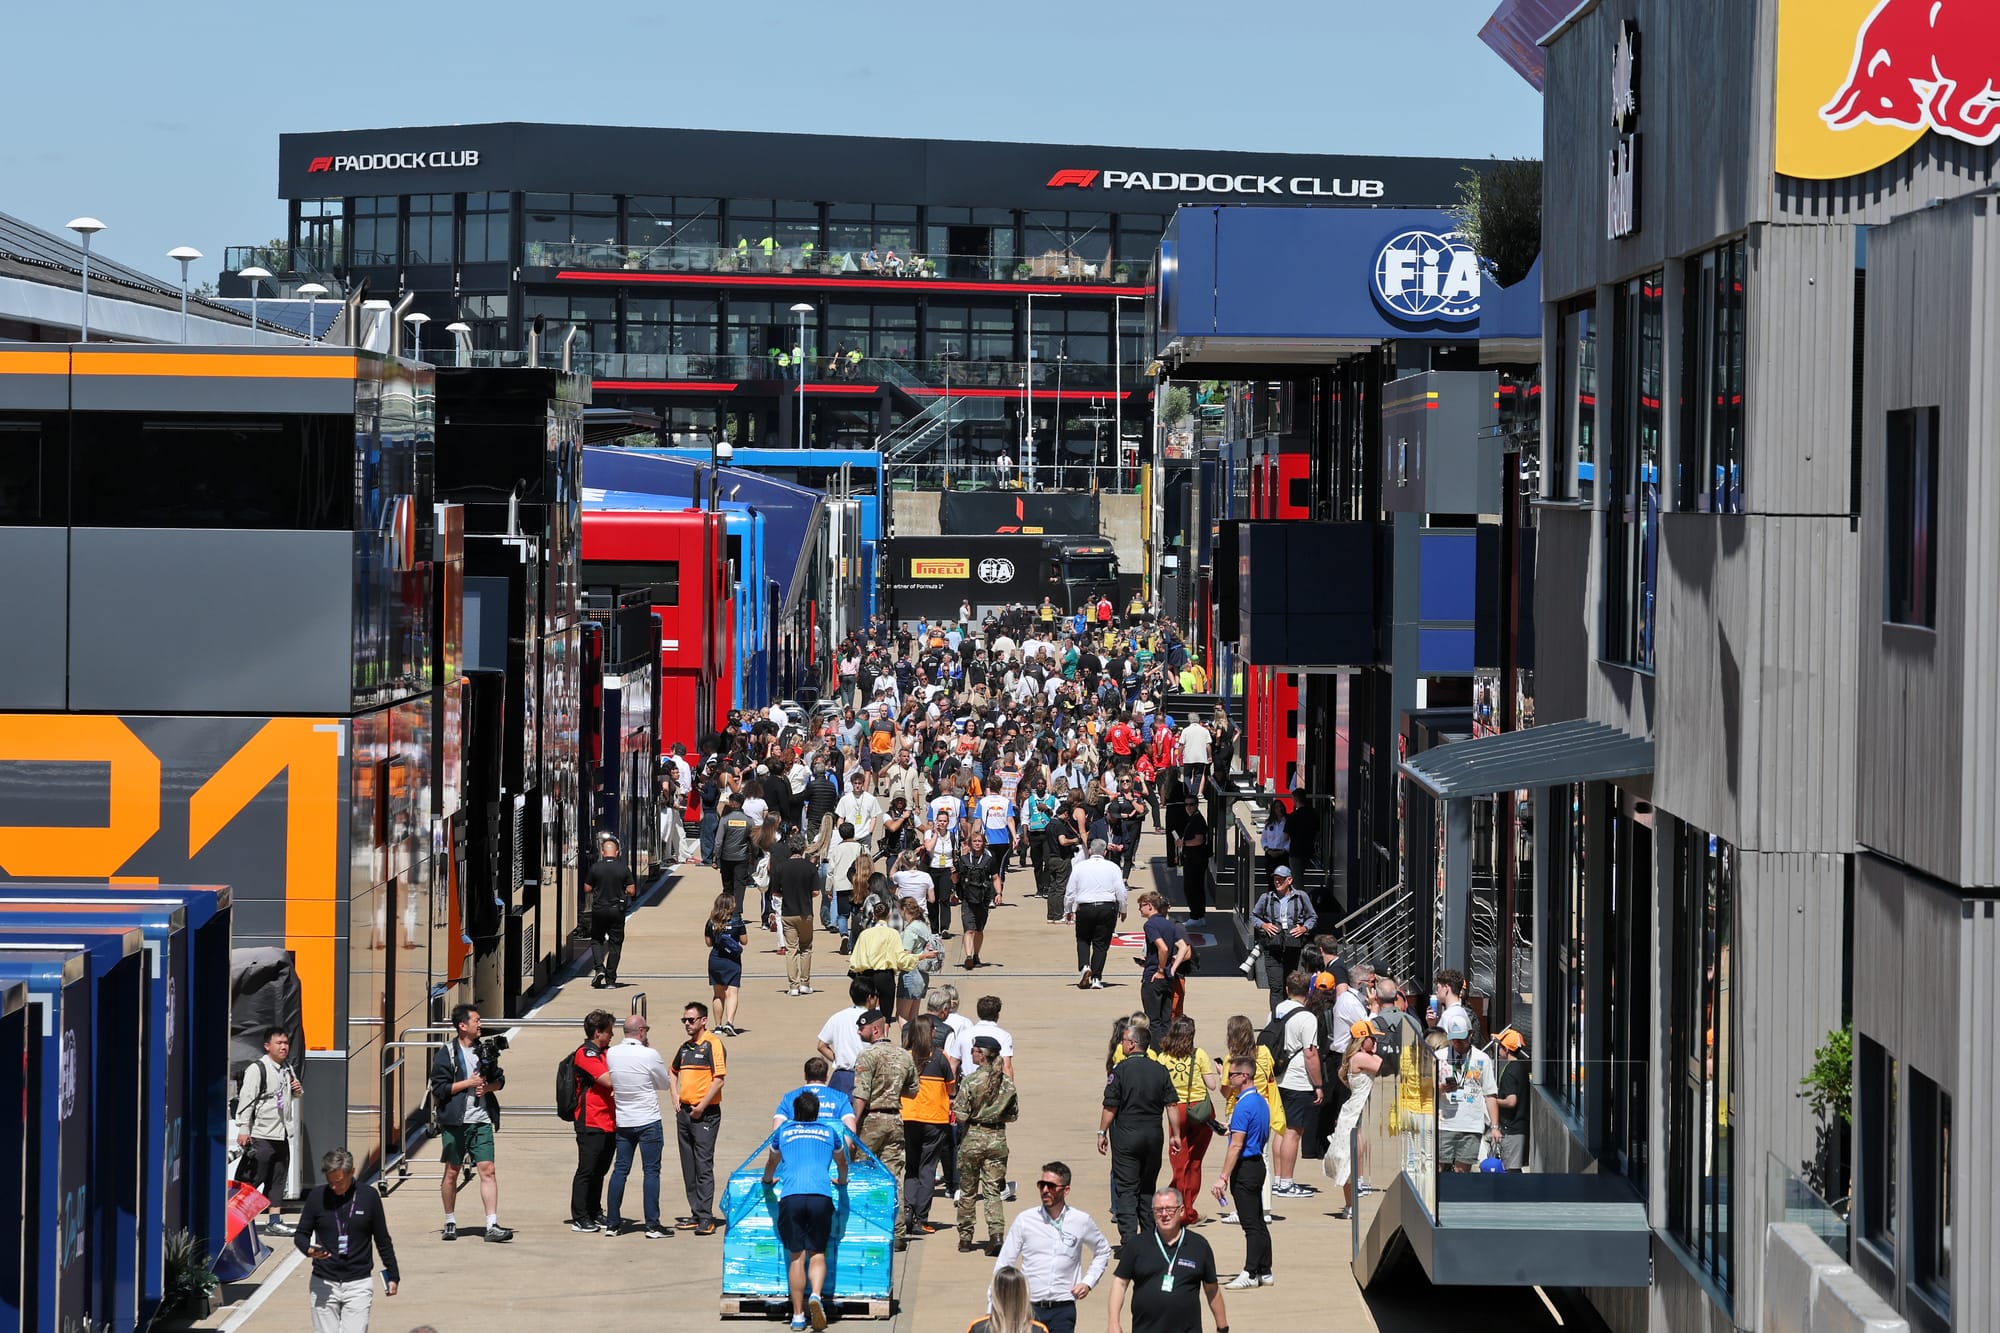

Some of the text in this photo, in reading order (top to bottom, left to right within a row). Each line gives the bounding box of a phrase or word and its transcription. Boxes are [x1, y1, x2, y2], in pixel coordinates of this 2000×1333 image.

[335, 152, 426, 171] PADDOCK
[429, 150, 479, 167] CLUB
[1103, 170, 1283, 194] PADDOCK
[1290, 177, 1384, 198] CLUB
[916, 562, 965, 574] PIRELLI
[783, 1129, 830, 1137] PETRONAS
